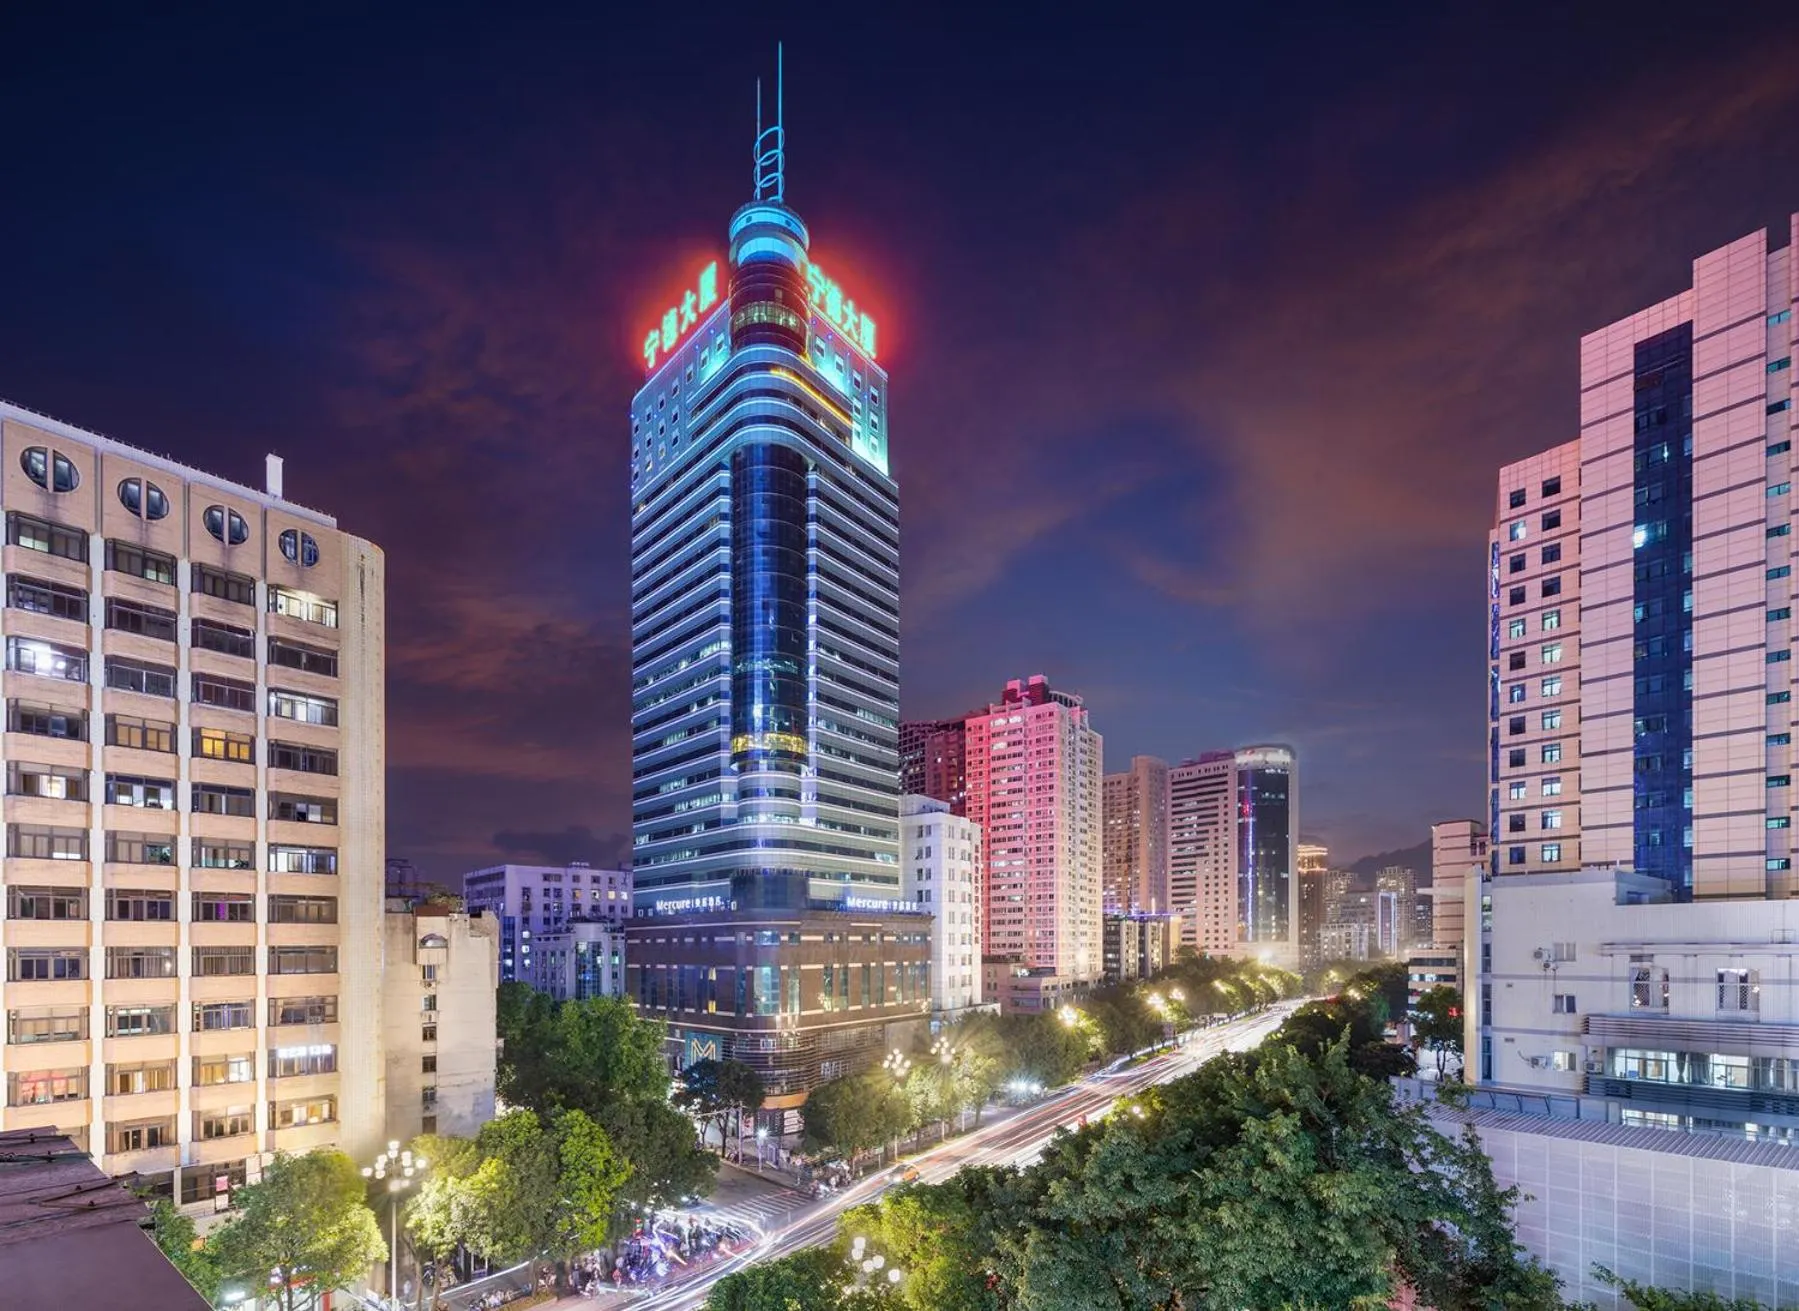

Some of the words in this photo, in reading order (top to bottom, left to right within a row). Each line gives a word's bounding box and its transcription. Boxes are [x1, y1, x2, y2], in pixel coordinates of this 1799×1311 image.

[656, 898, 691, 910] Mercure
[847, 896, 888, 910] Mercure
[690, 1038, 716, 1062] M
